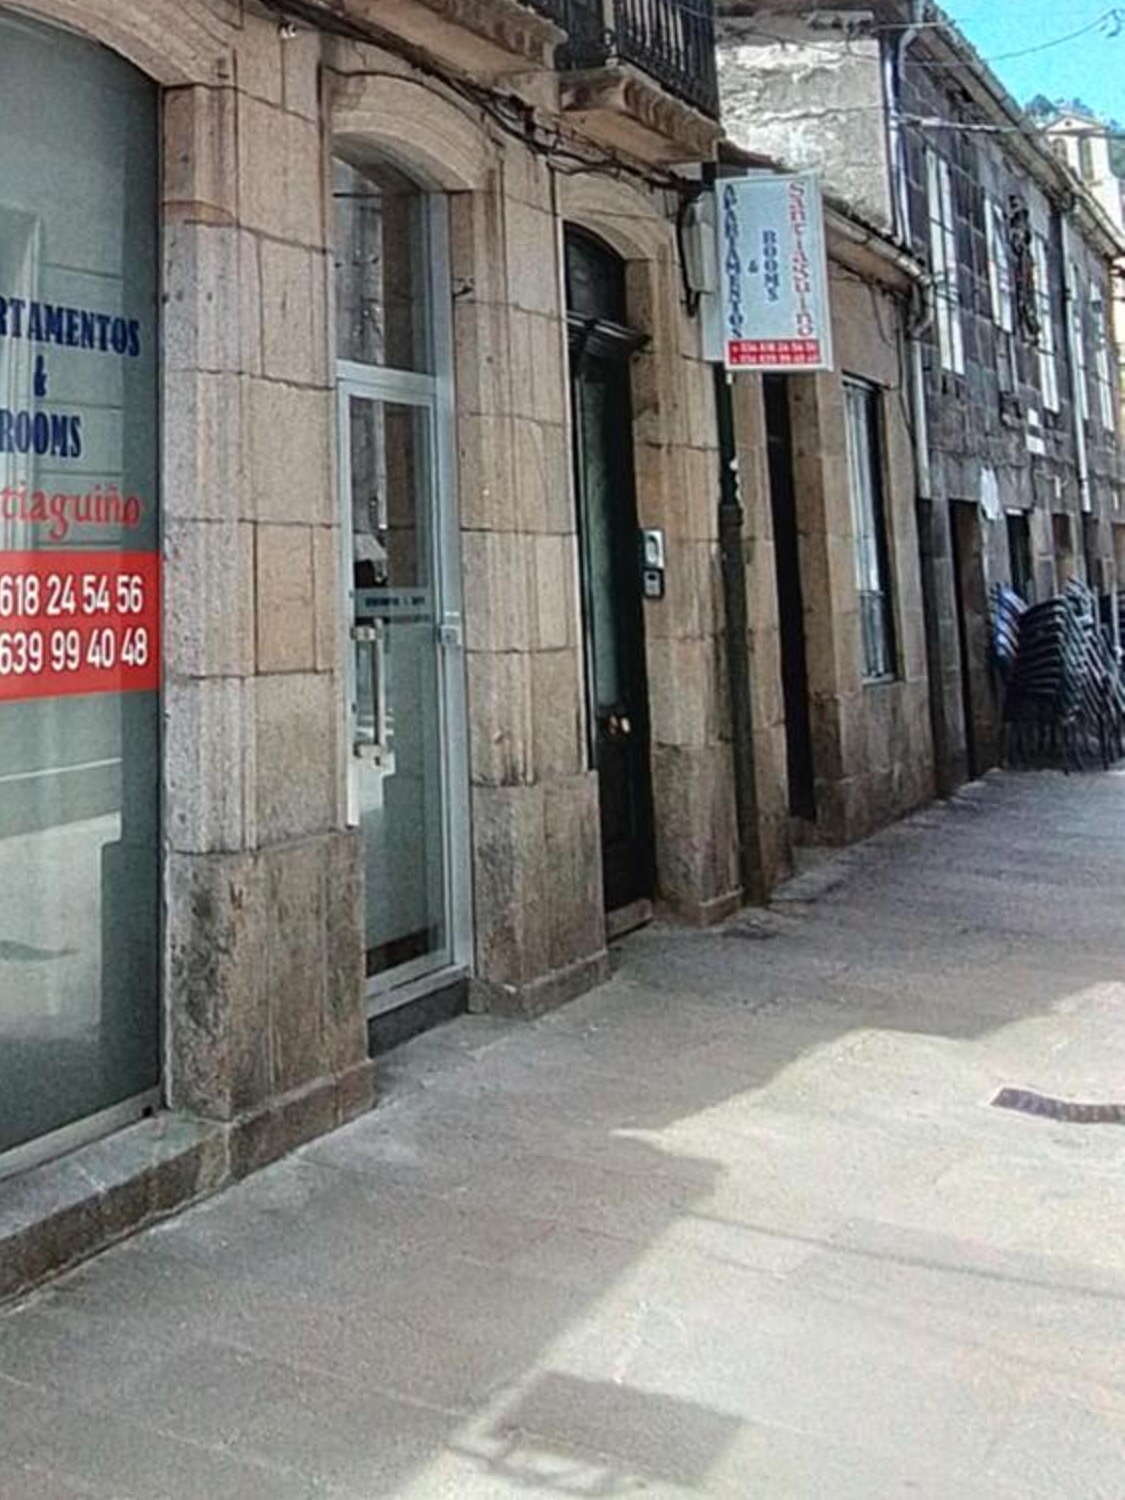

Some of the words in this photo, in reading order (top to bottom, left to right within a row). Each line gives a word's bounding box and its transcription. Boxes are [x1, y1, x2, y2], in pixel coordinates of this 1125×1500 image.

[762, 230, 779, 302] ROOMS
[33, 354, 47, 398] &
[46, 574, 77, 616] 24
[82, 574, 111, 614] 54
[116, 574, 144, 614] 56
[51, 629, 81, 672] 99
[87, 627, 116, 669] 40
[121, 626, 149, 668] 48
